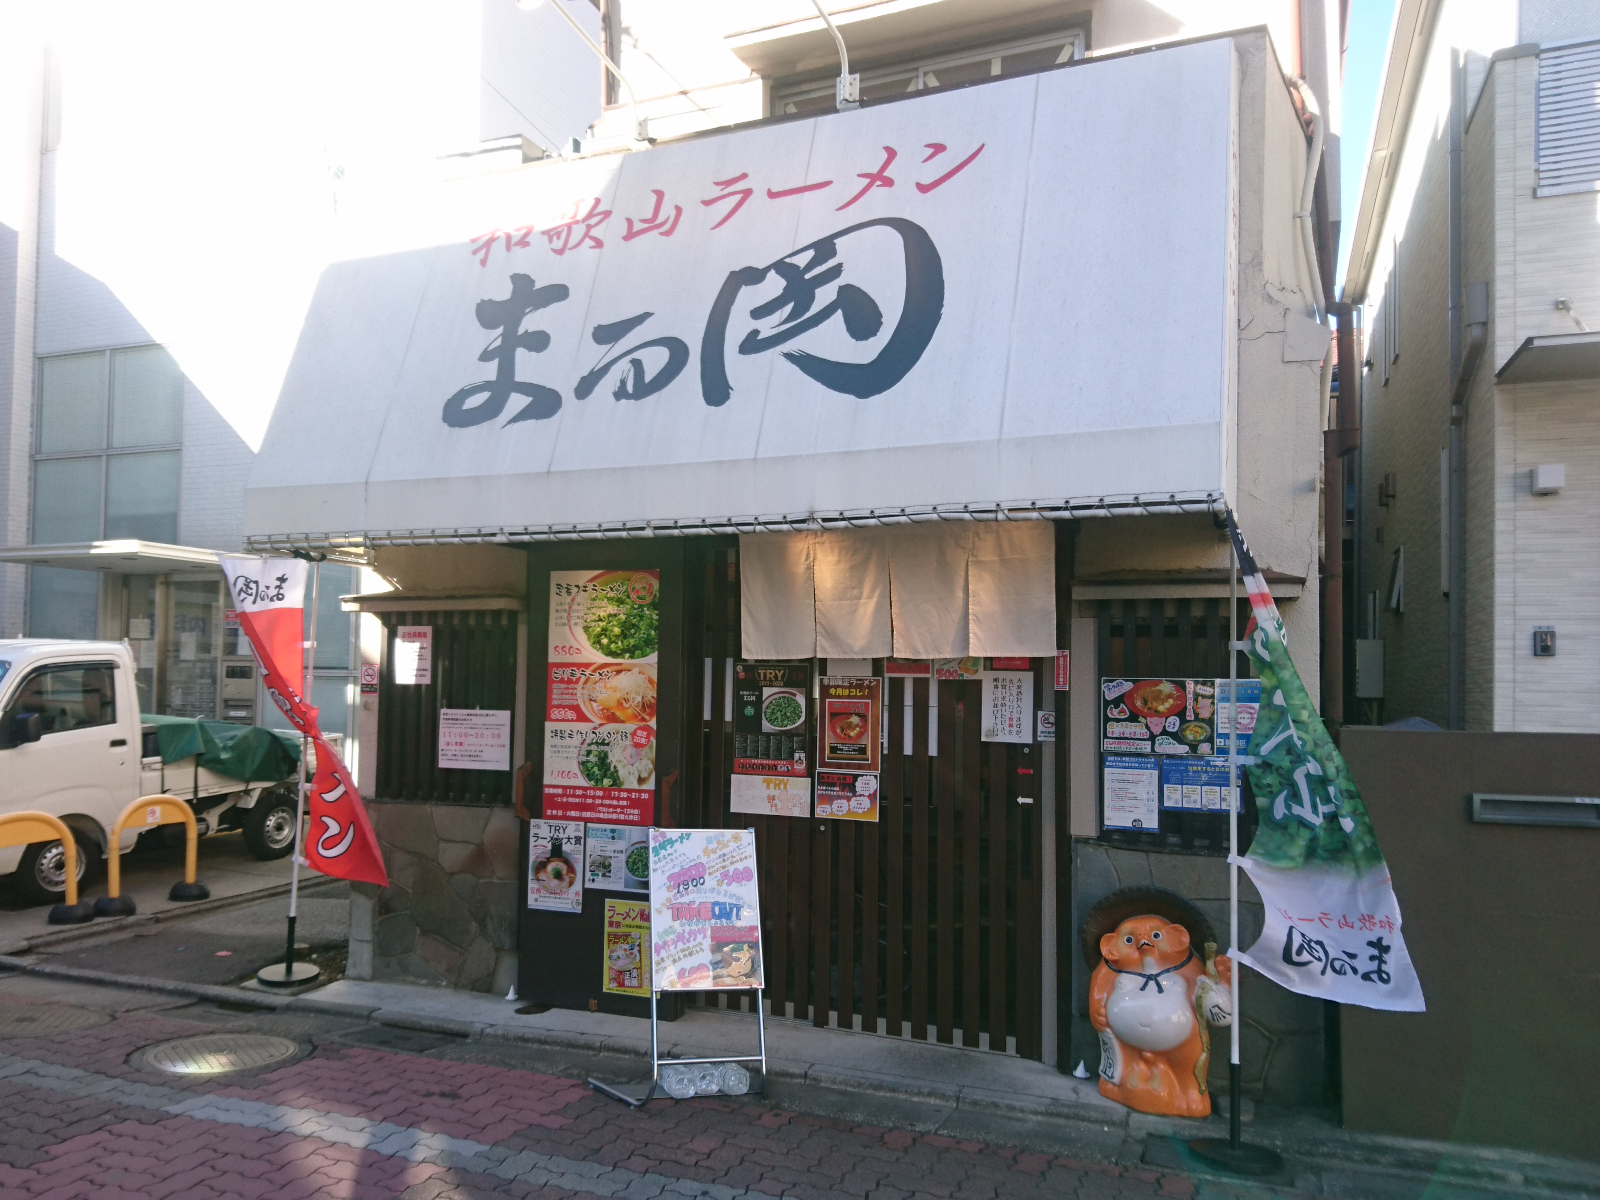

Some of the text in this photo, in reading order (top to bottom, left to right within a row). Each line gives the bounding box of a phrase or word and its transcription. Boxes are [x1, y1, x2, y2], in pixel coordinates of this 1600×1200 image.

[471, 143, 985, 267] 和歌山ラーメン
[442, 217, 944, 428] まる岡
[553, 668, 616, 680] ピリ辛ラーメン
[758, 670, 784, 681] TRY
[829, 688, 869, 696] 今月はコレ!
[762, 778, 790, 791] TRY
[548, 825, 568, 834] TRY
[532, 833, 583, 846] ラーメン大賞
[720, 866, 754, 887] 500
